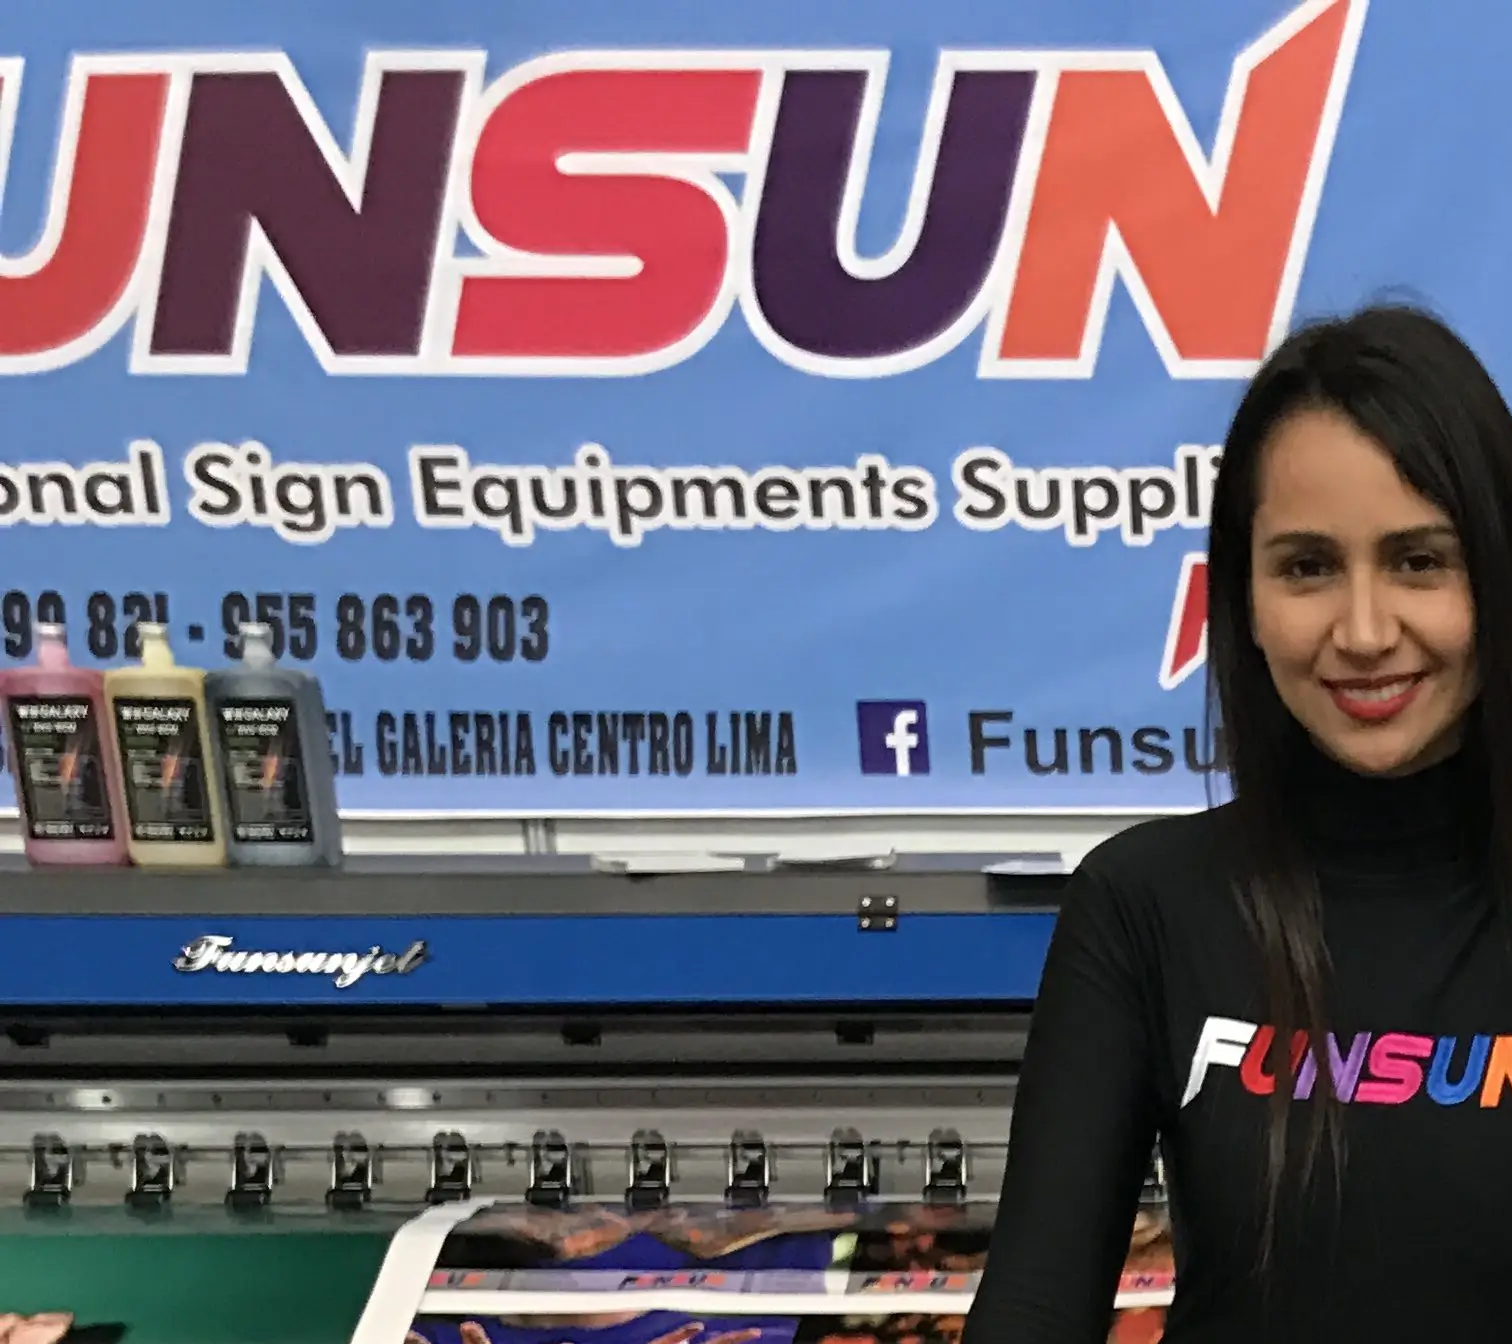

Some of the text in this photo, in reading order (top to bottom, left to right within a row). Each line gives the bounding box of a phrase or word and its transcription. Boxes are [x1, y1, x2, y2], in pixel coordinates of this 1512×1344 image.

[0, 450, 165, 516] nal
[192, 451, 384, 532] Sign
[417, 454, 930, 536] Equipments
[335, 593, 434, 661] 863
[452, 595, 550, 662] 903
[375, 710, 537, 776] GALERIA
[547, 711, 695, 777] CENTRO
[705, 712, 797, 777] LIMA
[173, 934, 431, 988] Funsunjet
